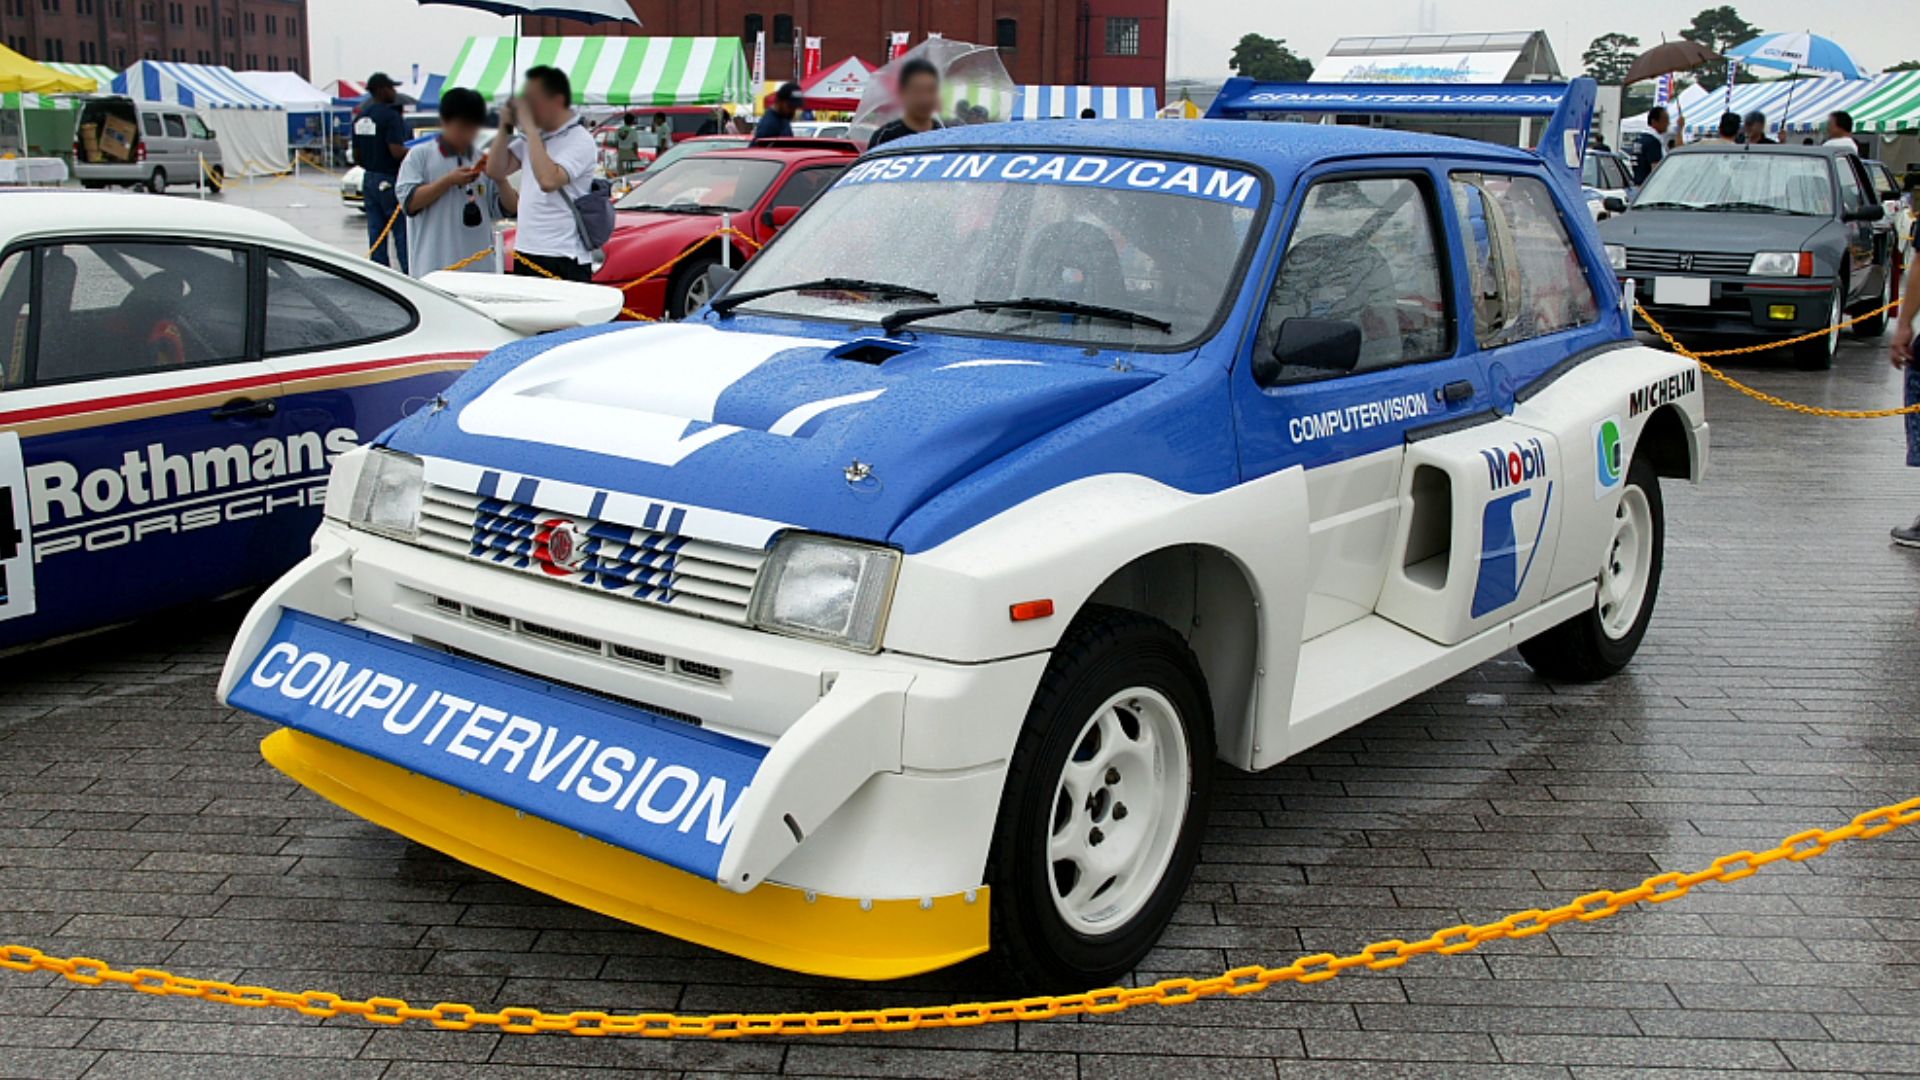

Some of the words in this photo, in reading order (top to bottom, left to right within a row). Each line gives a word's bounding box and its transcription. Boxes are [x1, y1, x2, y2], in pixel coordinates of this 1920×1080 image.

[1250, 92, 1563, 104] COMPUTERVISION
[834, 154, 938, 187] FIRST
[941, 154, 995, 178] IN
[1000, 158, 1255, 202] CAD/CAM
[1289, 393, 1428, 444] COMPUTERVISION
[1629, 368, 1696, 418] MICHELIN
[27, 427, 360, 527] Rothmans
[1480, 437, 1546, 491] Mobil
[34, 487, 328, 564] PORSCHE
[250, 642, 750, 846] COMPUTERVISION
